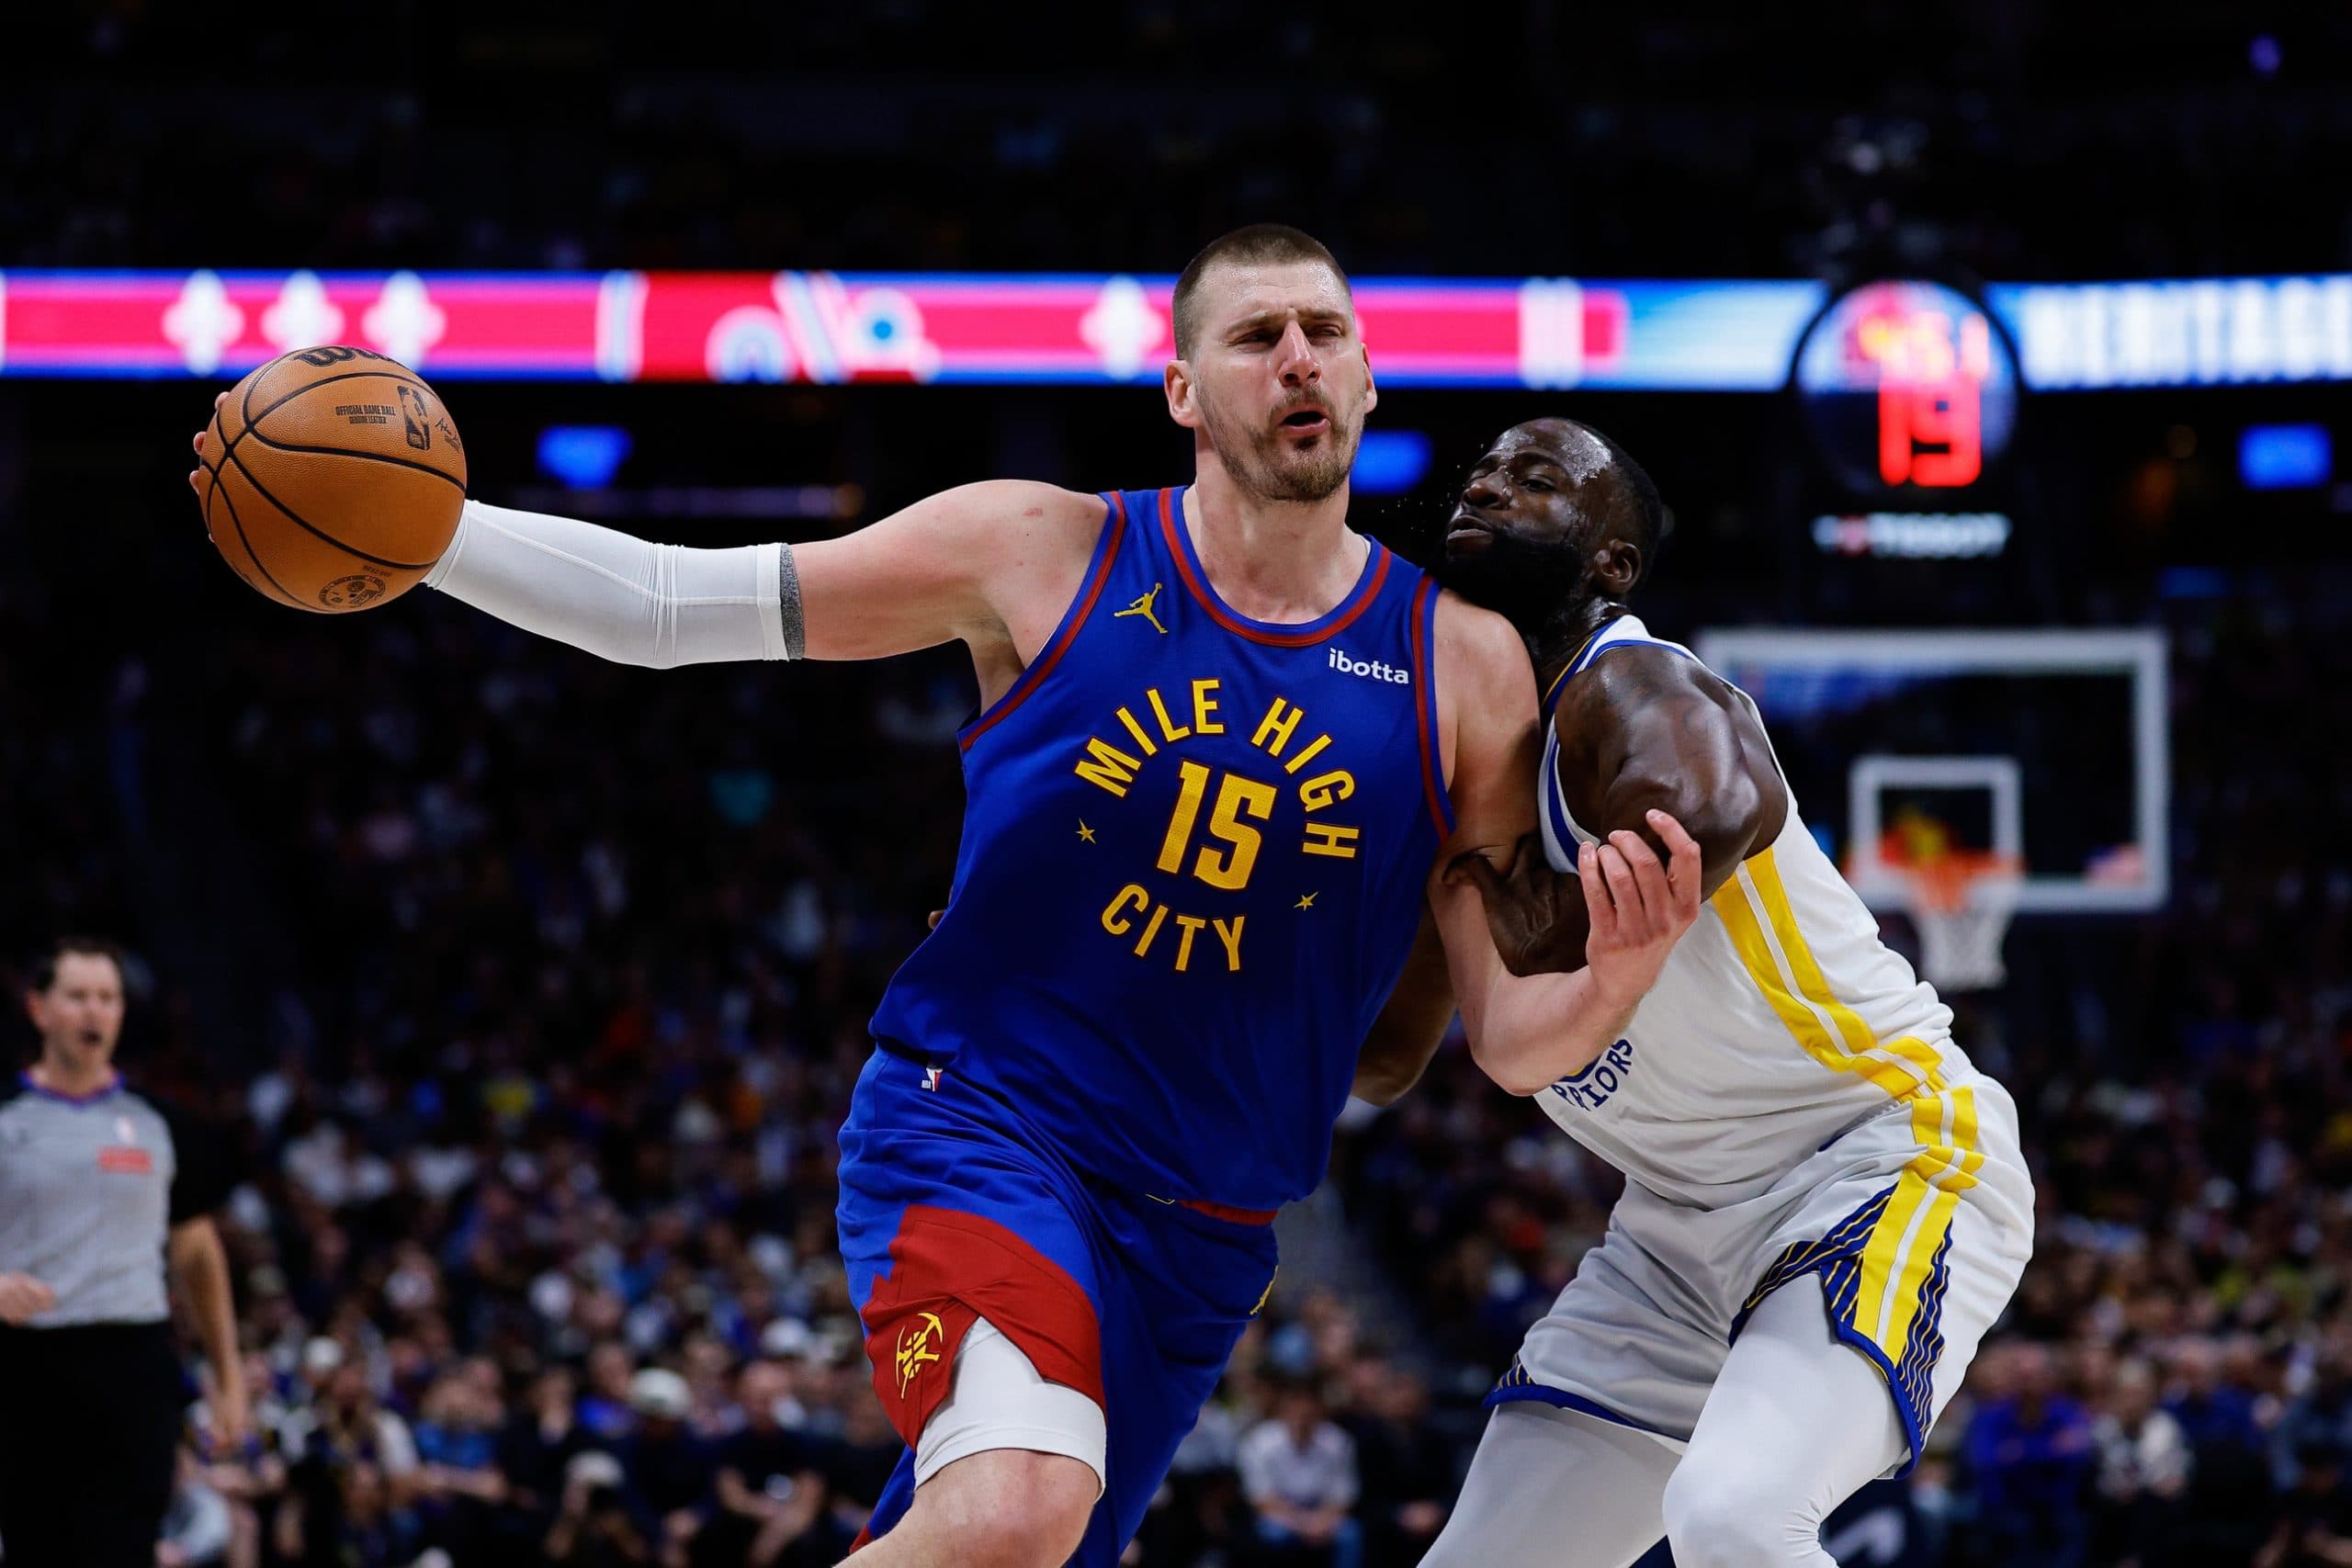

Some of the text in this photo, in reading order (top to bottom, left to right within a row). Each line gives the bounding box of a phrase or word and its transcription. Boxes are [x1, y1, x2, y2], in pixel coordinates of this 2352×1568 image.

[1328, 647, 1409, 685] ibotta
[1074, 678, 1361, 860] MILE HIGH
[1156, 759, 1279, 891] 15
[1102, 882, 1246, 972] CITY
